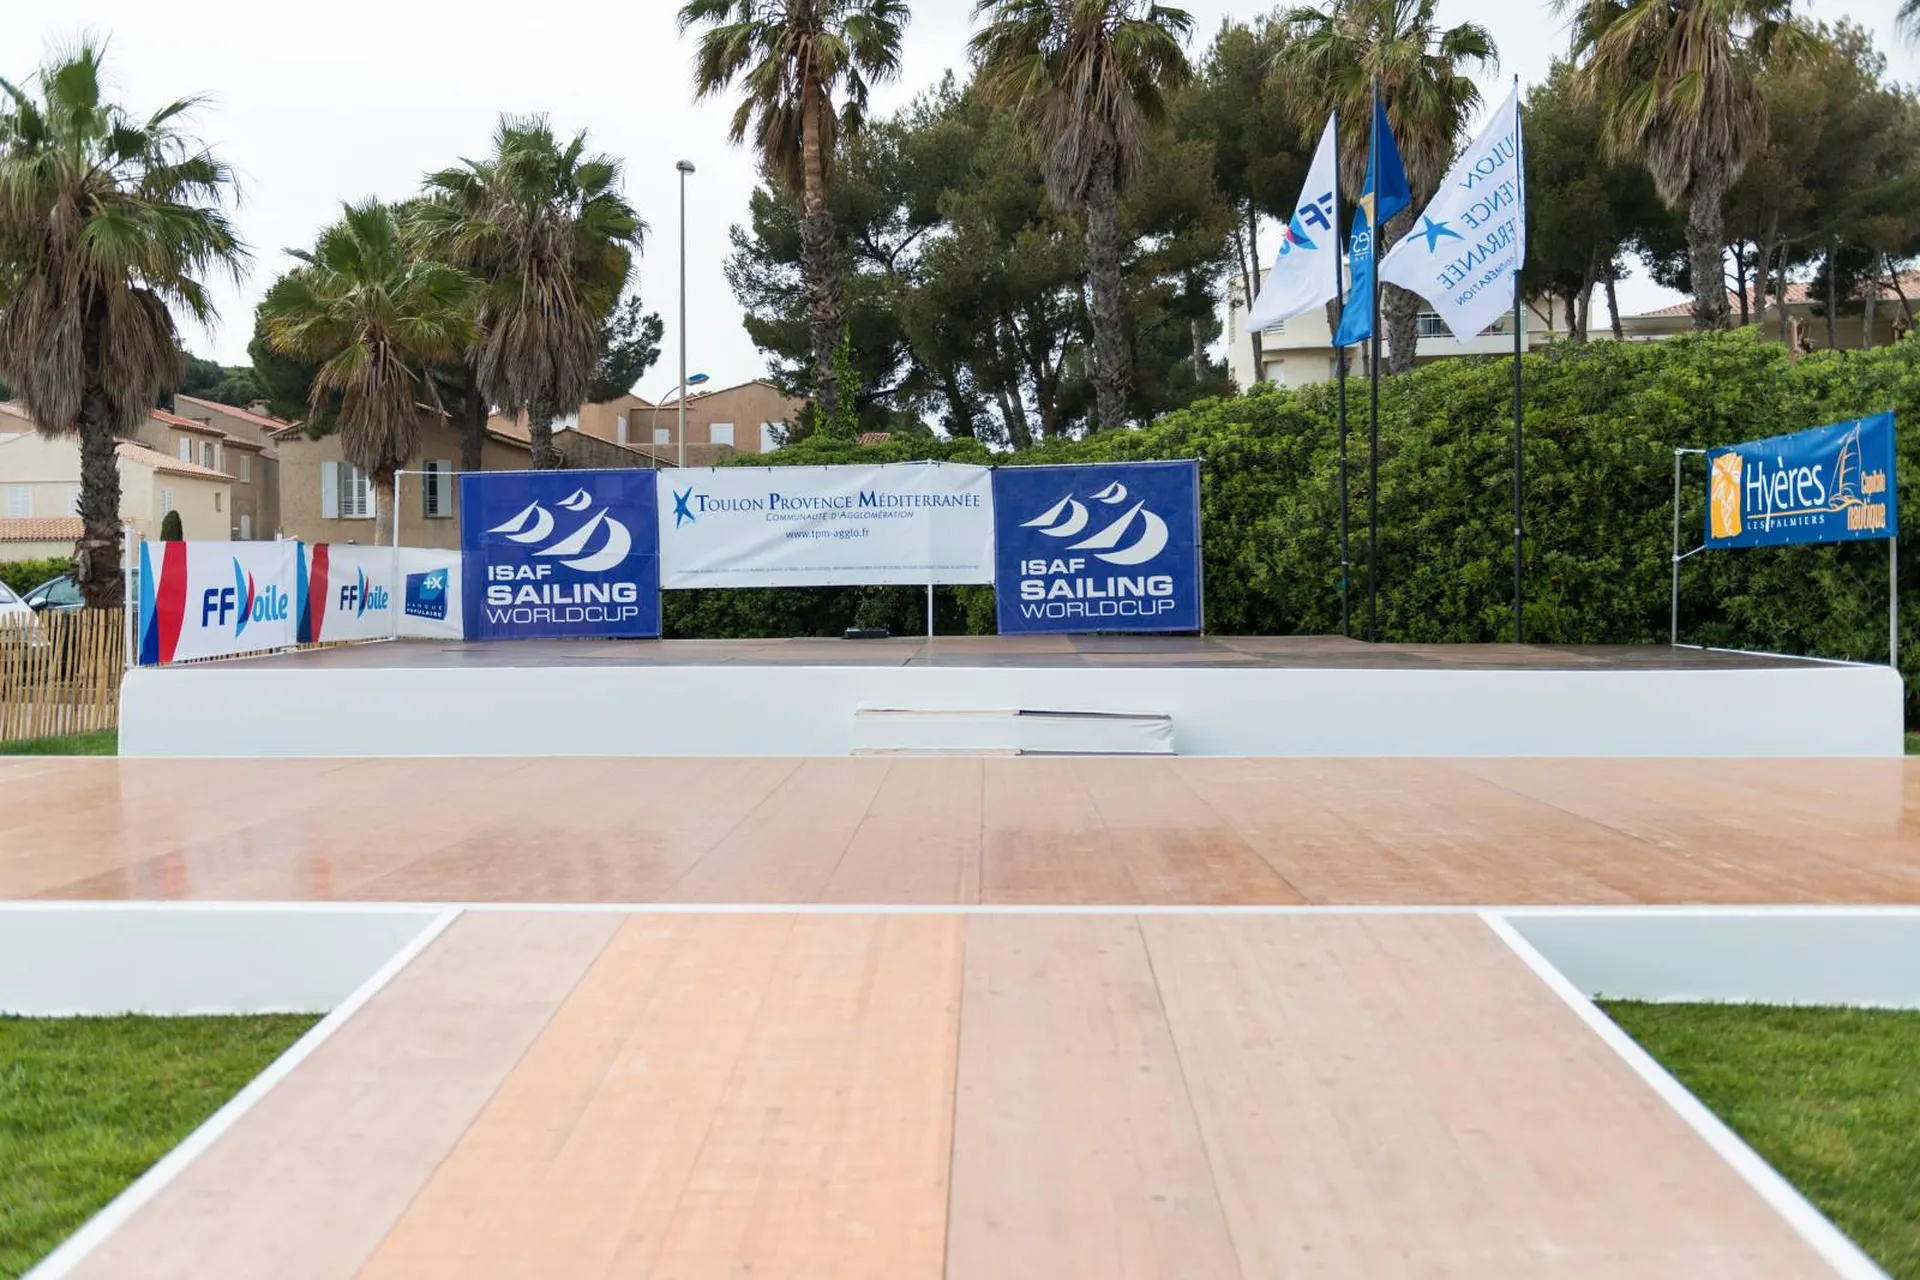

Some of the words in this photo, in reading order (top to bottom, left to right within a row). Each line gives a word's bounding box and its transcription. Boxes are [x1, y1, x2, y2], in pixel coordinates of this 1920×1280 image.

[695, 494, 763, 512] TOULON
[768, 493, 853, 511] PROVENCE
[858, 490, 980, 508] MÉDITERRANÉE
[1746, 456, 1826, 532] Hyères
[765, 512, 827, 522] COMMUNAUTÉ
[1746, 520, 1765, 530] LES
[1770, 515, 1825, 529] PALMIERS
[1847, 497, 1886, 533] nautique
[785, 527, 870, 540] www.tpm-agglo.fr
[487, 564, 552, 581] ISAF
[1020, 558, 1086, 576] ISAF
[486, 582, 637, 606] SAILING
[1020, 575, 1174, 601] SAILING
[486, 606, 639, 624] WORLDCUP
[1020, 599, 1175, 619] WORLDCUP
